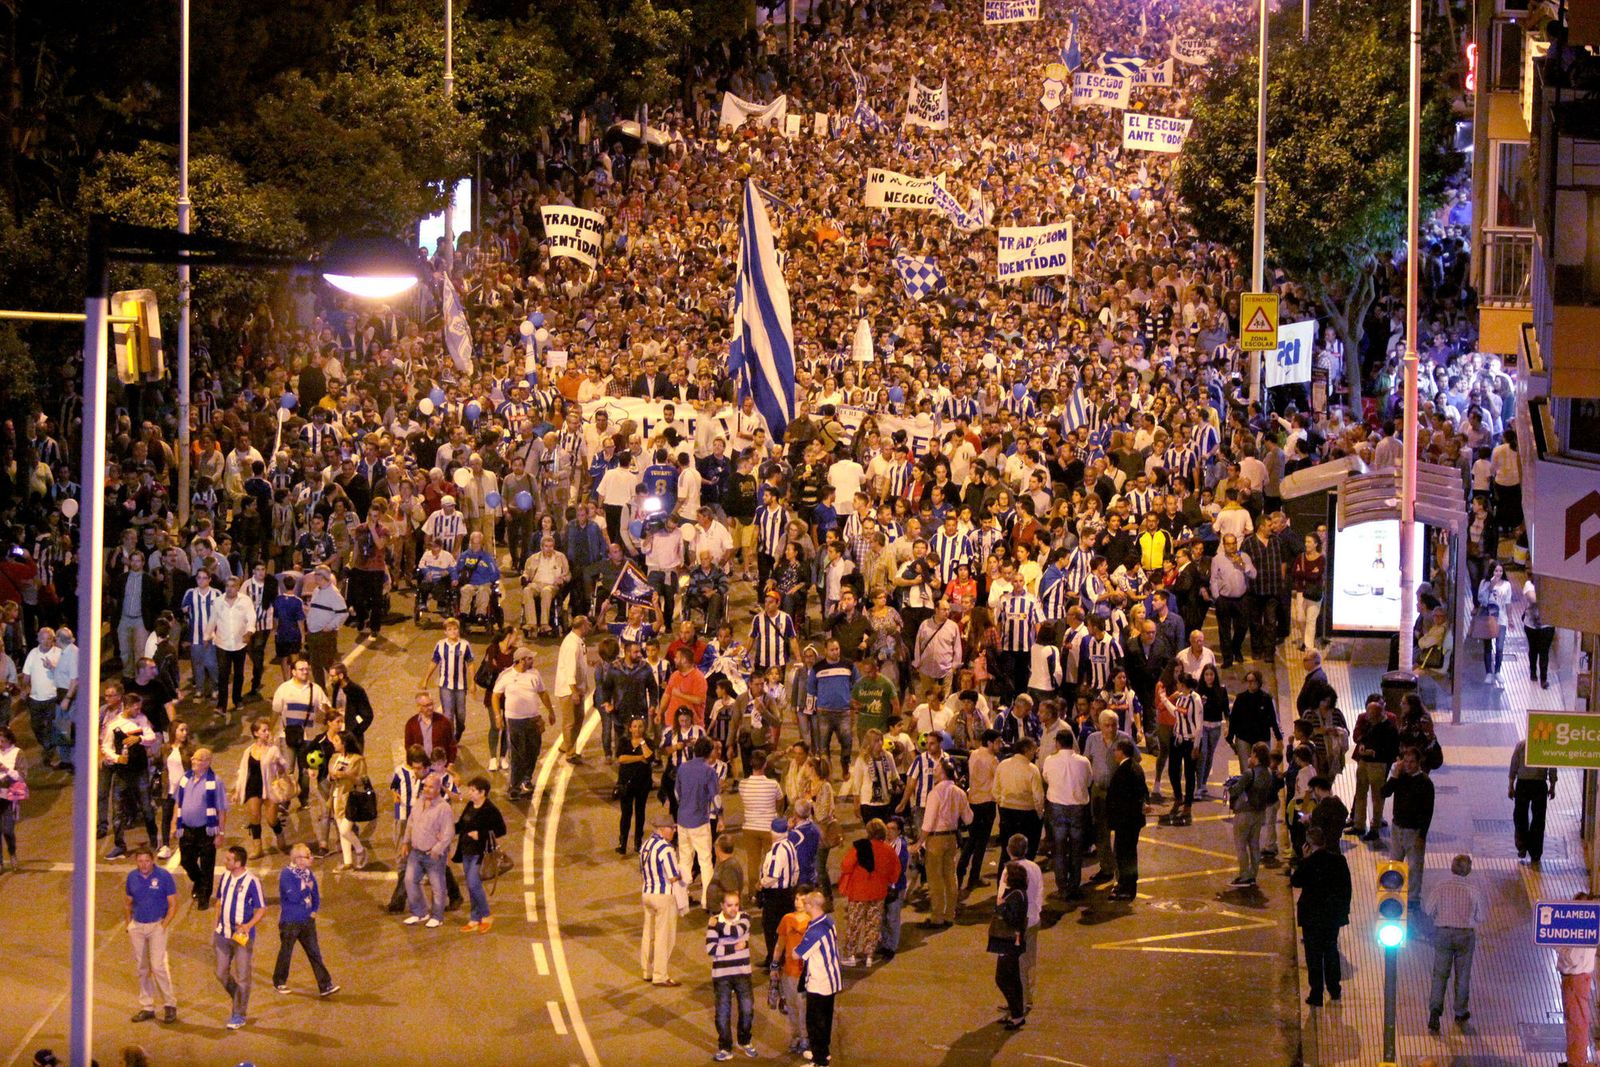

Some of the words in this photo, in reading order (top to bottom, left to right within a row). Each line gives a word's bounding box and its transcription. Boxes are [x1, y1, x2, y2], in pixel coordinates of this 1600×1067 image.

[985, 9, 1024, 20] SOLUCION
[1087, 75, 1123, 89] ESCUDO
[1152, 72, 1165, 82] YA
[1074, 88, 1093, 97] ANTE
[1098, 89, 1119, 99] TODO
[1129, 116, 1140, 127] EL
[1128, 130, 1155, 142] ANTE
[871, 173, 885, 183] NO
[884, 191, 935, 205] NEGOCIO
[544, 213, 603, 235] TRADICIO
[576, 229, 581, 237] E
[999, 227, 1067, 250] TRADICION
[547, 235, 600, 260] DENTIDA
[999, 253, 1067, 276] IDENTIDAD
[1554, 910, 1596, 919] ALAMEDA
[1539, 928, 1597, 939] SUNDHEIM
